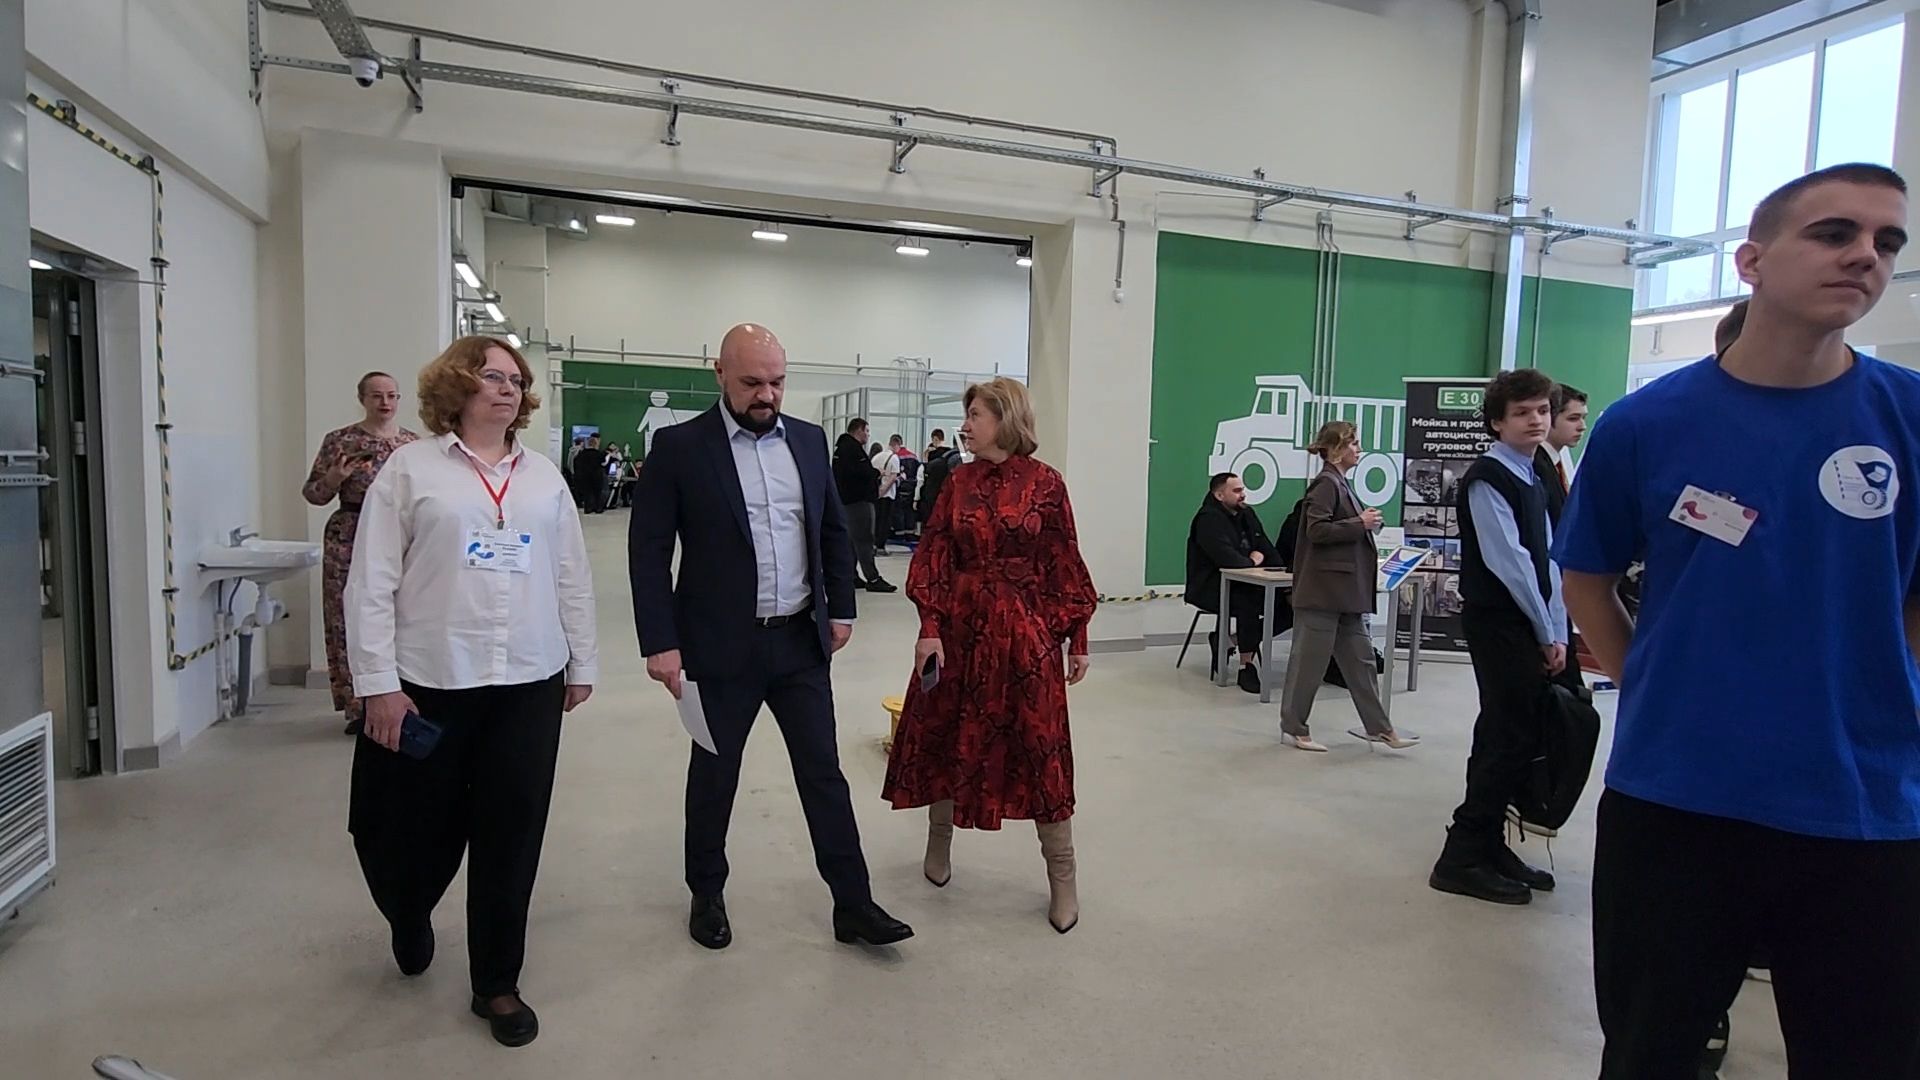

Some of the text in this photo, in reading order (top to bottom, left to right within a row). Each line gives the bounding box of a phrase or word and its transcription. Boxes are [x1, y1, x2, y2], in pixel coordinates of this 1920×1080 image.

[1444, 392, 1479, 404] E 30
[1412, 418, 1448, 427] Мойка
[1425, 431, 1491, 441] автоцистер
[1423, 442, 1473, 452] грузовое
